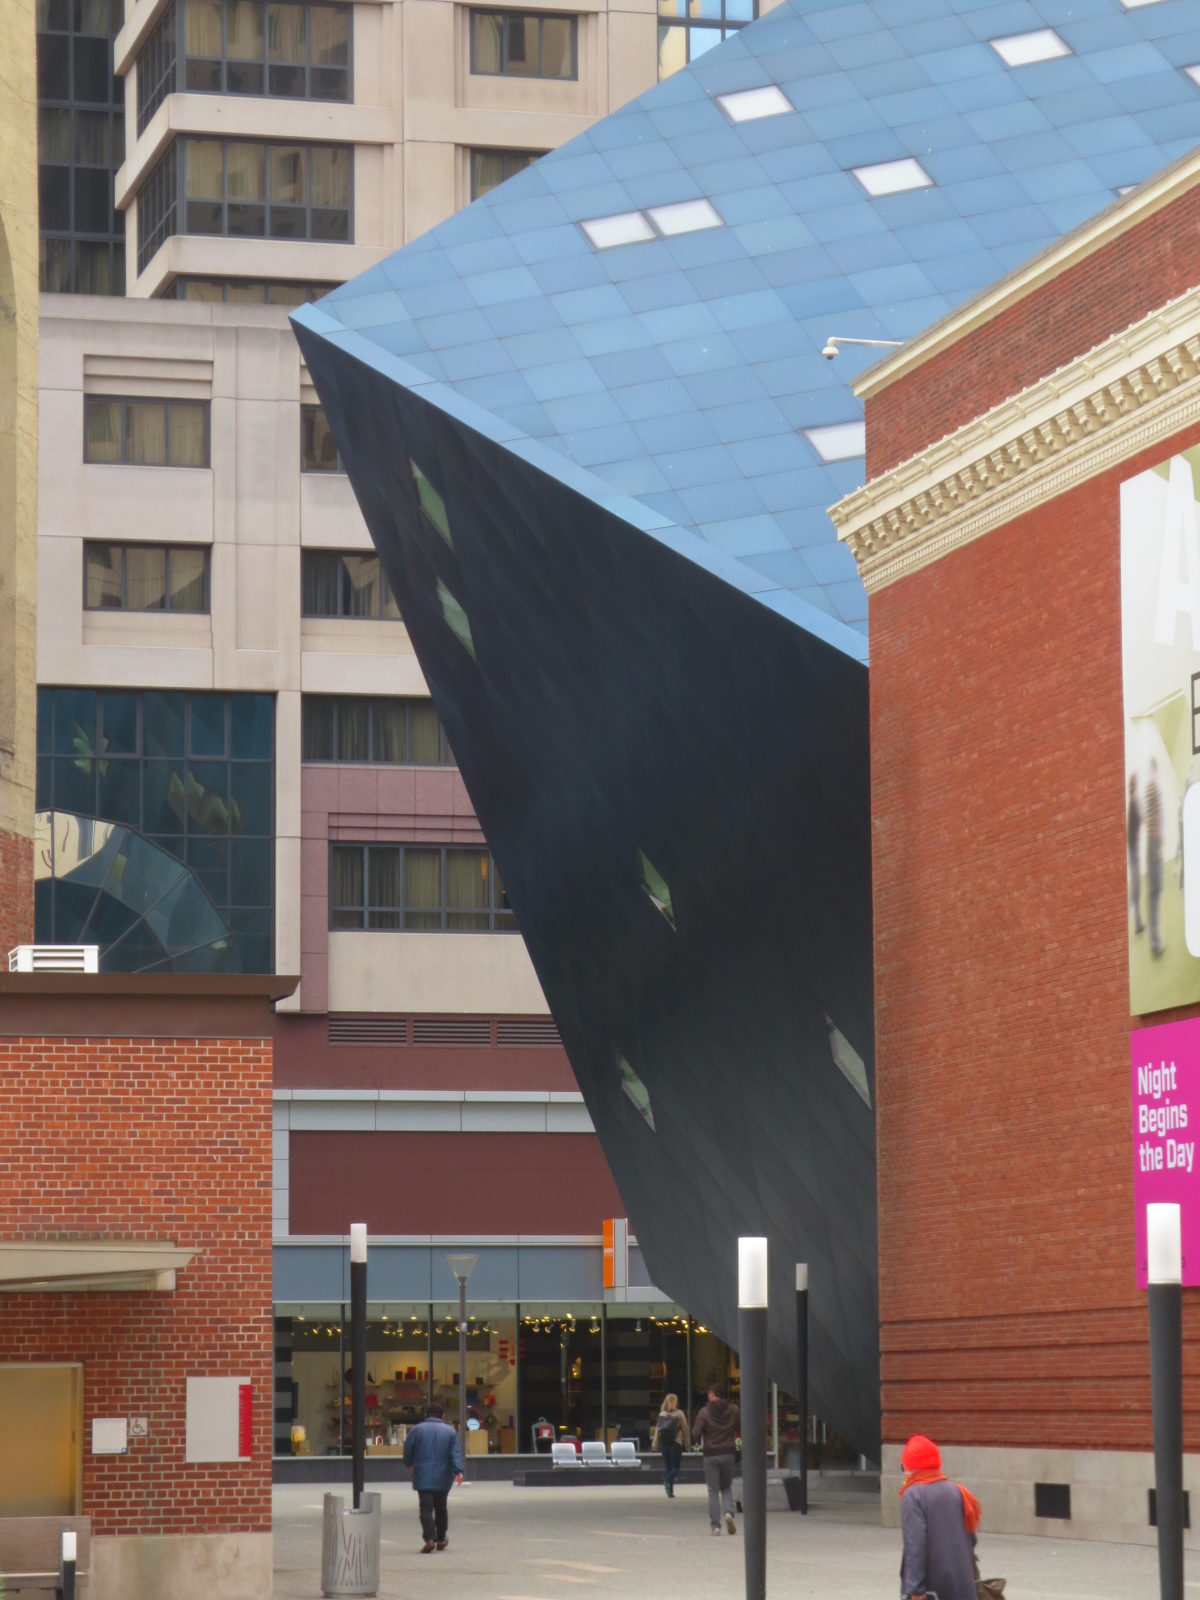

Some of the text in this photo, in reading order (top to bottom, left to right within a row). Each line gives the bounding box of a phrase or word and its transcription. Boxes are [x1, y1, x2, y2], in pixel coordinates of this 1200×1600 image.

[1138, 1061, 1177, 1099] Night
[1139, 1098, 1188, 1137] Begins
[1139, 1139, 1194, 1173] the Day
